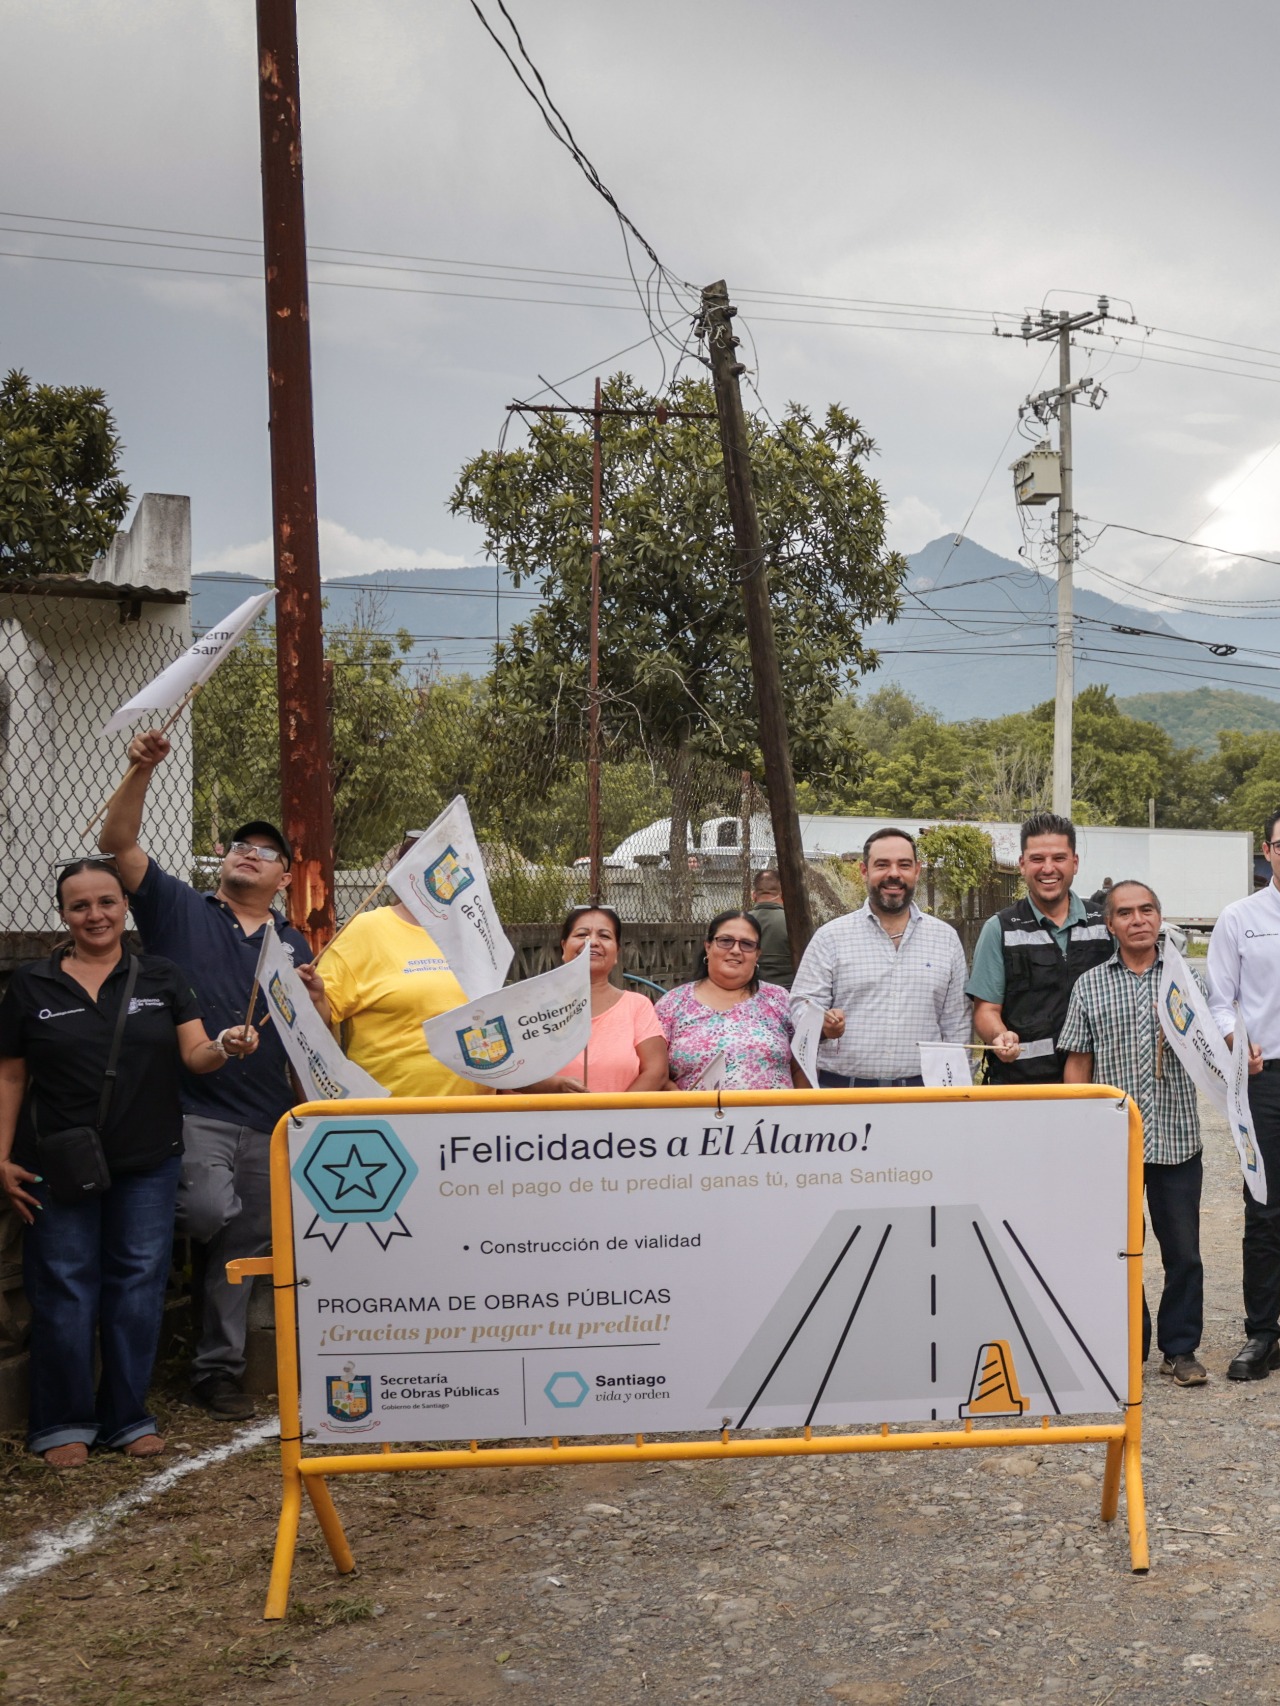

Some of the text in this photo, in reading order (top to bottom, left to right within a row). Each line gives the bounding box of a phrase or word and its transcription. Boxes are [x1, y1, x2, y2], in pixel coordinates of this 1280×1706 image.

[460, 904, 475, 920] de
[518, 999, 578, 1027] Gobierno
[522, 998, 588, 1041] de Santiago
[440, 1119, 871, 1171] ¡Felicidades a El Álamo!
[439, 1168, 934, 1197] Con el pago de tu predial ganas tú, gana Santiago
[481, 1234, 700, 1254] Construcción de vialidad
[318, 1289, 670, 1313] PROGRAMA DE OBRAS PÚBLICAS
[320, 1314, 670, 1346] ¡Gracias por pagar tu predial!
[381, 1374, 447, 1385] Secretaría
[596, 1374, 665, 1387] Santiago
[381, 1387, 499, 1399] de Obras Públicas
[596, 1389, 669, 1403] vida y orden
